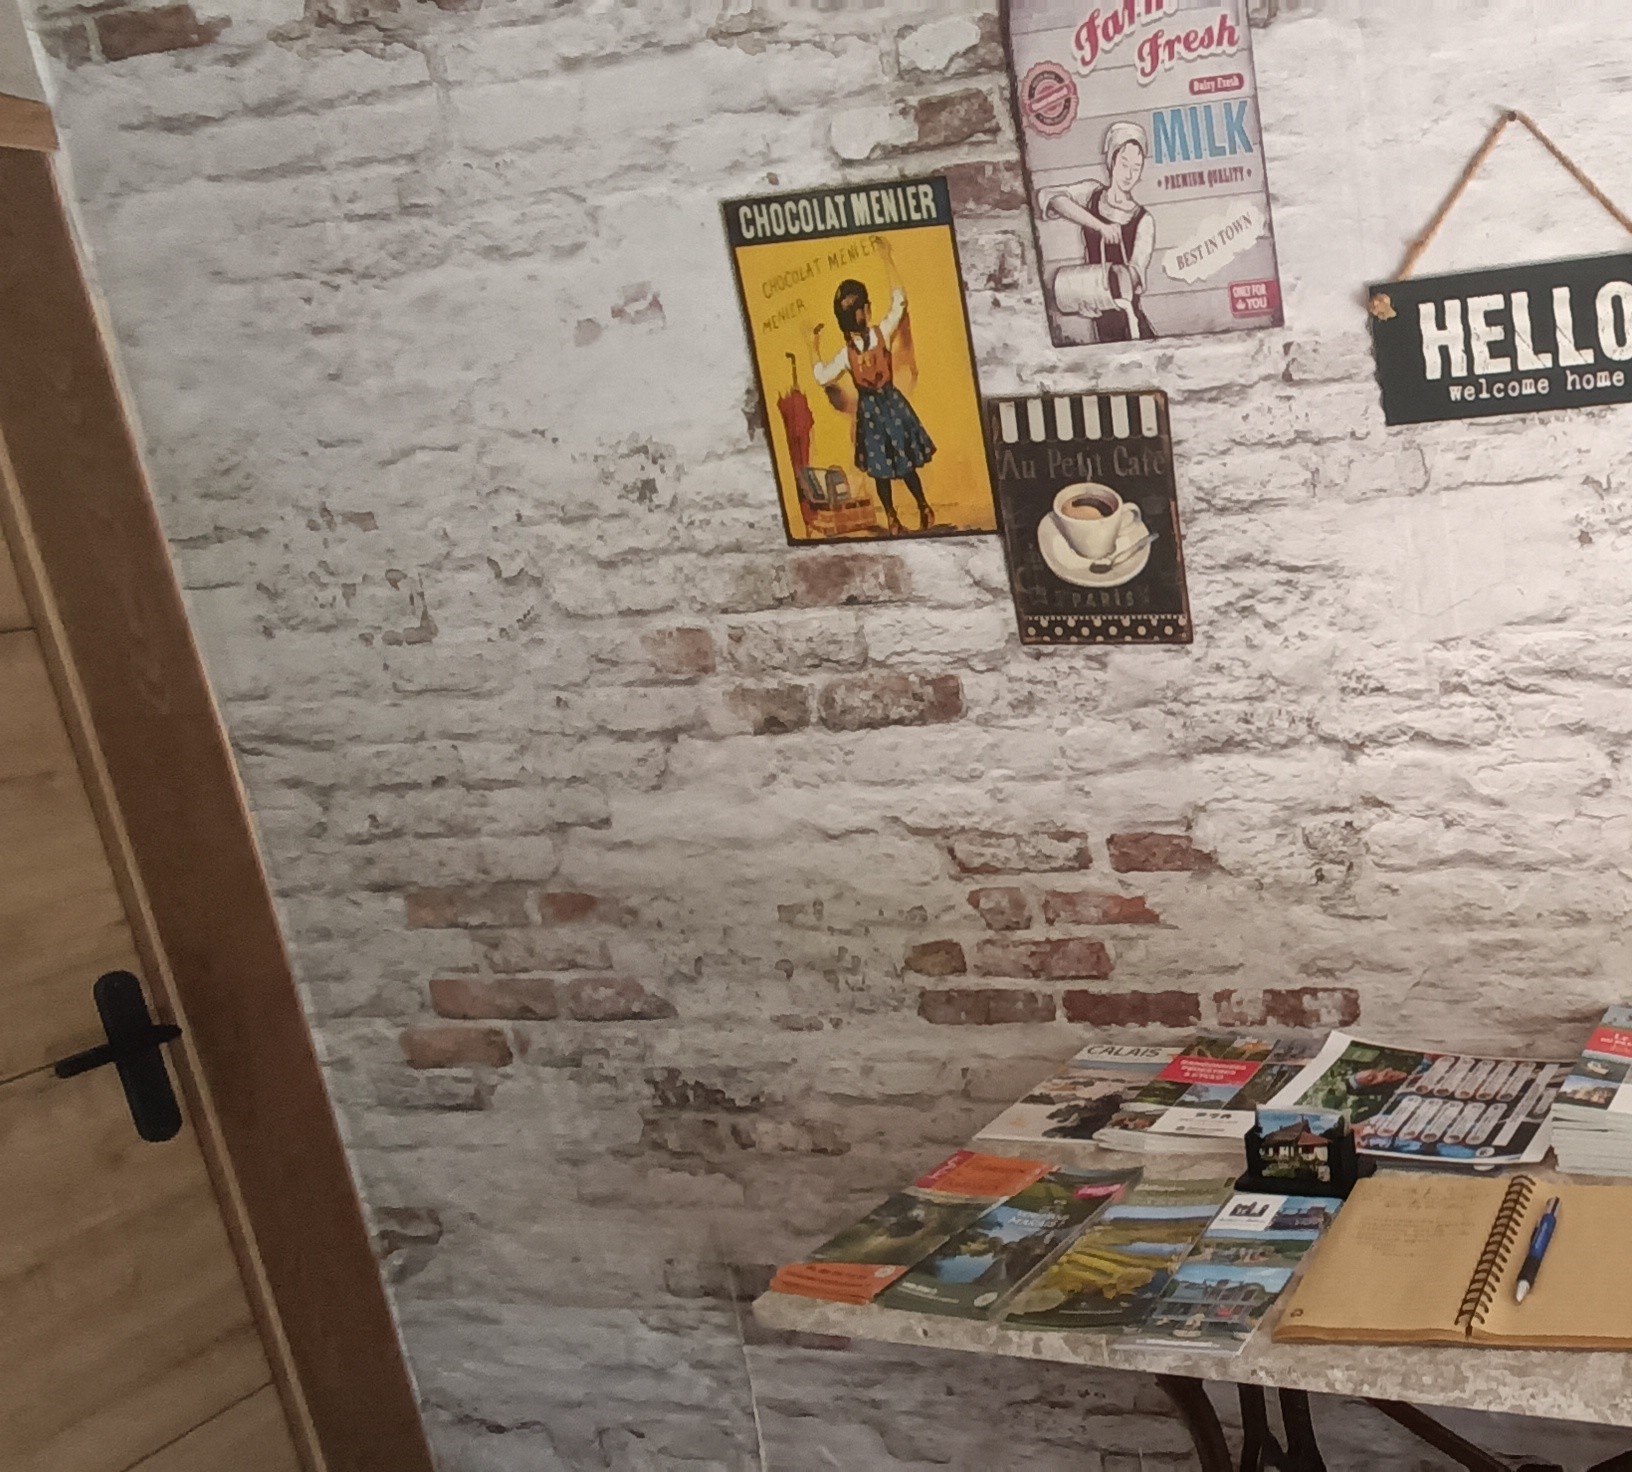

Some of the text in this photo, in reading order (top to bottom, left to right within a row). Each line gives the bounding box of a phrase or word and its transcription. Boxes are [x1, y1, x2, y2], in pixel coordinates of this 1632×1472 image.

[1137, 14, 1239, 77] Fresh
[1152, 100, 1254, 164] MILK
[1164, 166, 1245, 190] PREMIUM QUALITY
[738, 183, 938, 240] CHOCOLAT MENIER
[1175, 211, 1254, 271] BEST IN TOWN
[762, 235, 881, 298] CHOCOLAT MENIER
[1245, 297, 1268, 311] YOU
[1251, 283, 1267, 297] FOR
[762, 297, 806, 334] MENIER
[1449, 370, 1625, 402] welcome home
[1000, 449, 1037, 481] Au
[1087, 1046, 1162, 1058] CALAIS
